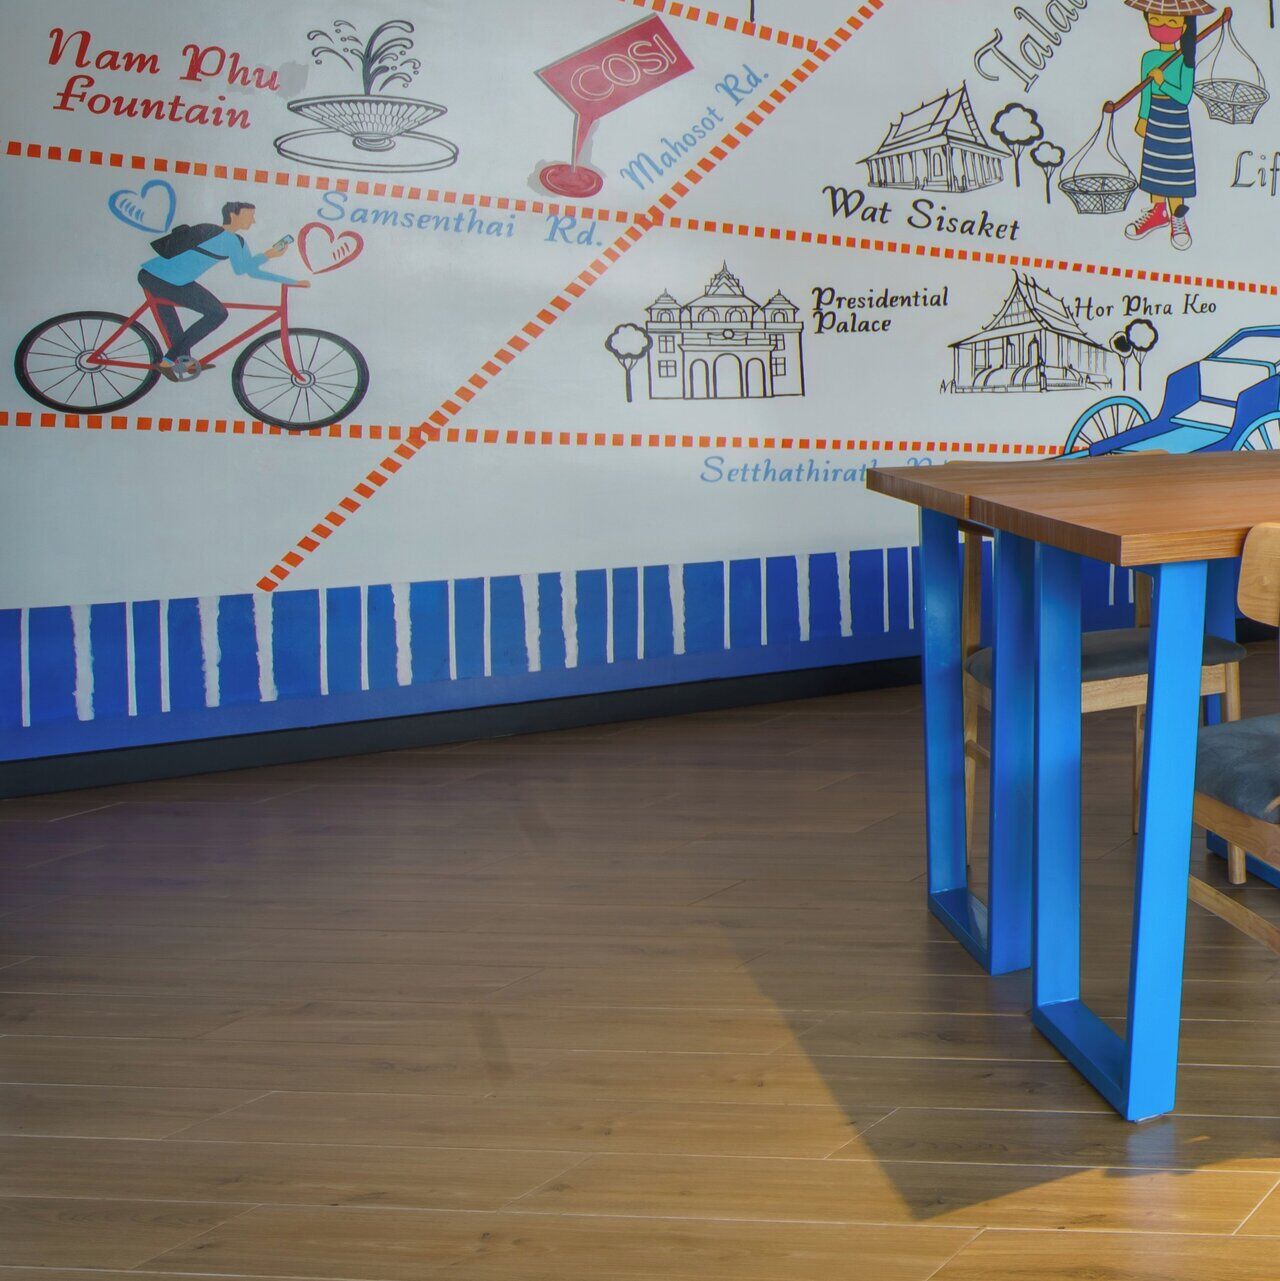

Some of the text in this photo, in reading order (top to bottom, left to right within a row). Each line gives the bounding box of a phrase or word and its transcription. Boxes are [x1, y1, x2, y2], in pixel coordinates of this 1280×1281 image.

[48, 27, 281, 91] Nam Phu
[571, 34, 677, 100] COSI
[52, 74, 251, 130] Fountain
[620, 64, 769, 191] Mahosot Rd.
[317, 190, 602, 247] Samsenthai Rd.
[822, 186, 1020, 241] Wat Sisaket
[811, 286, 949, 312] Presidential
[813, 310, 892, 334] Palace
[1074, 293, 1217, 319] Hor Phra Keo
